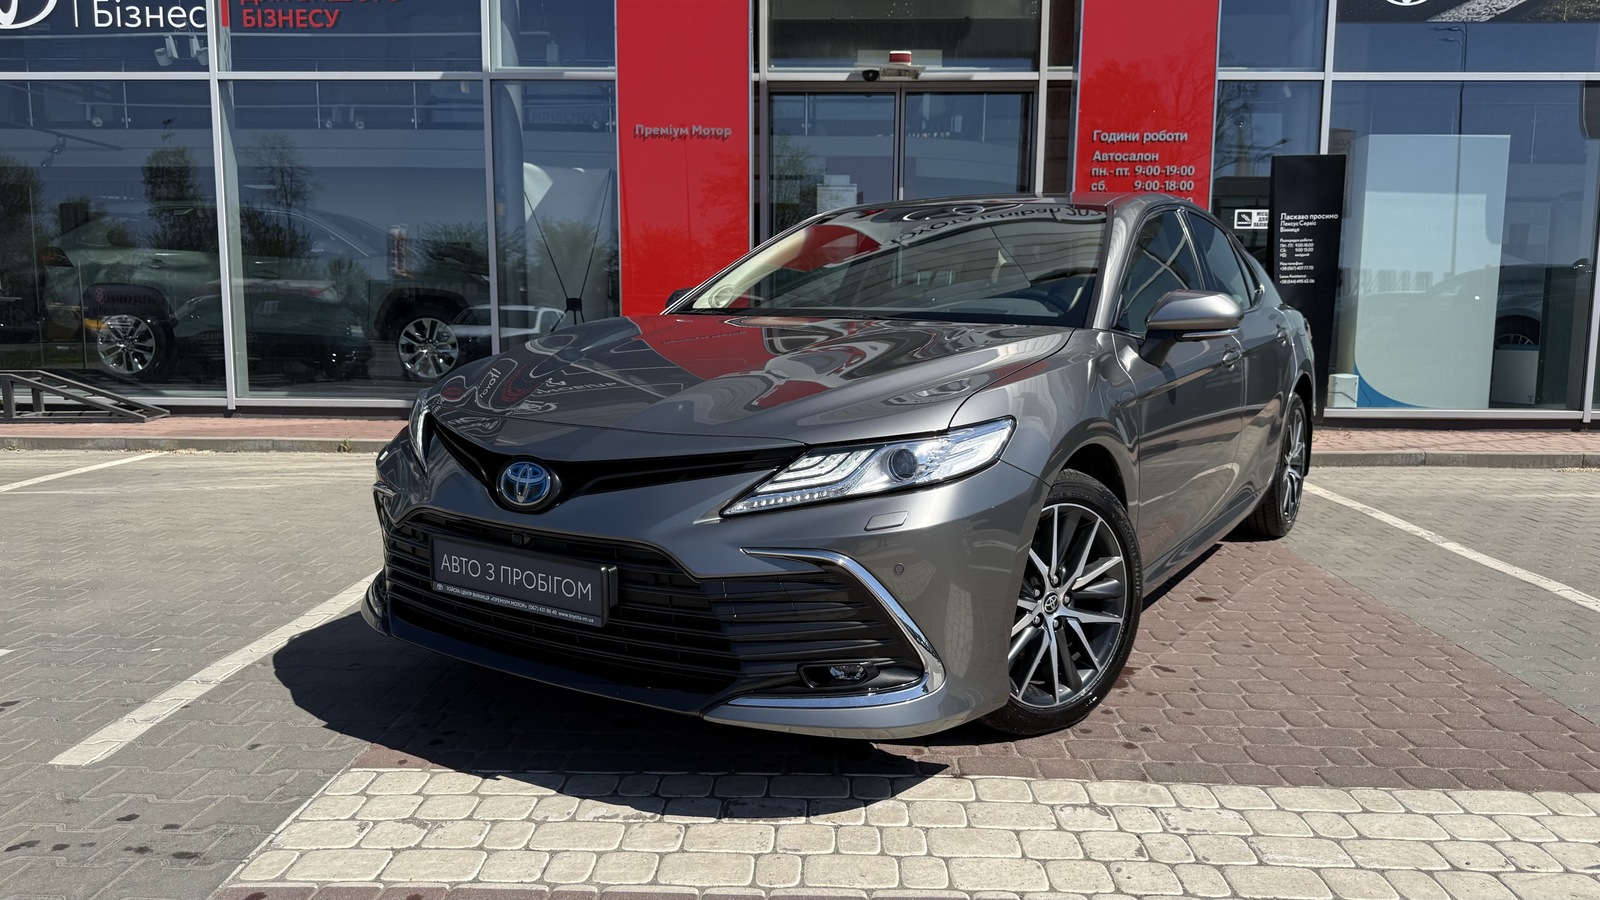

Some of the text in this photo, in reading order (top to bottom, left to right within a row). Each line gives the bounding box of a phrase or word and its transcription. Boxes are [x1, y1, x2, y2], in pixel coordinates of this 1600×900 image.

[93, 0, 207, 28] Бізнес
[242, 8, 340, 29] БІЗНЕСУ
[634, 124, 733, 138] Преміум Мотор
[1092, 130, 1188, 144] Години роботи
[1092, 150, 1159, 162] Автосалон
[1280, 212, 1339, 221] Ласкаво просимо
[441, 553, 482, 579] АВТО
[500, 565, 593, 602] ПРОБІГОМ
